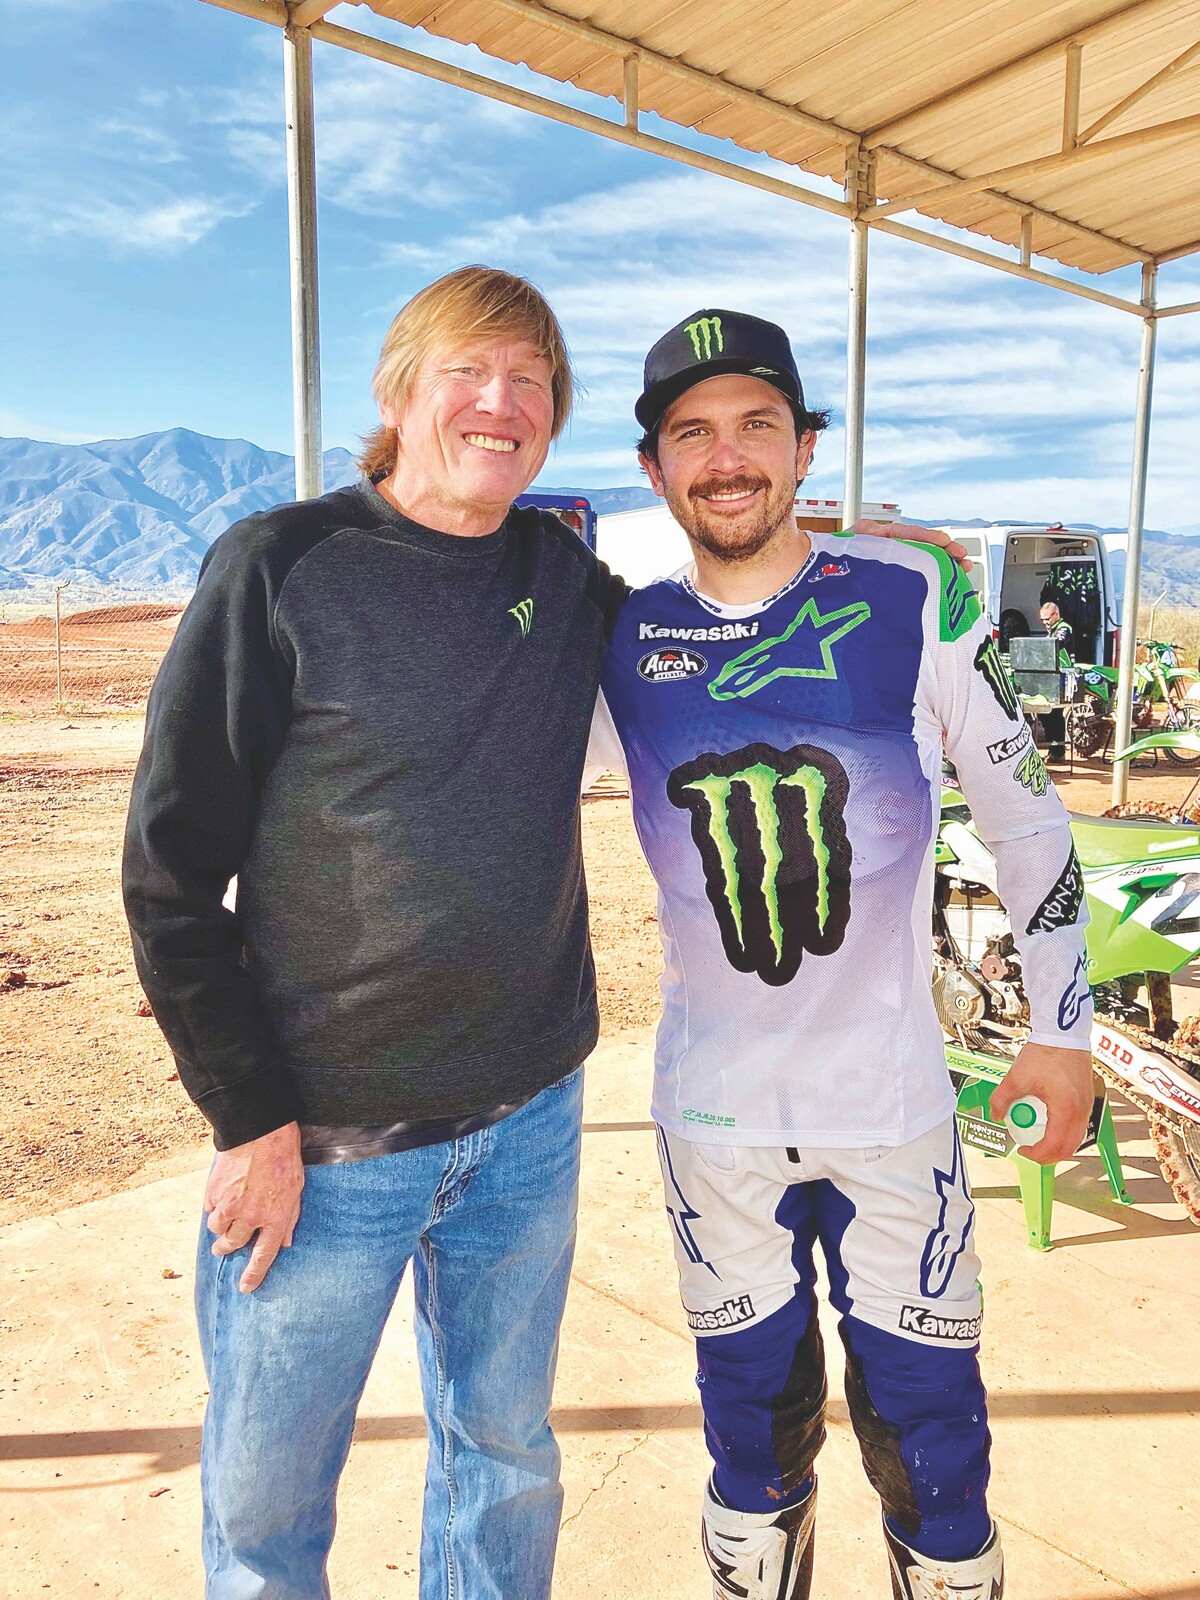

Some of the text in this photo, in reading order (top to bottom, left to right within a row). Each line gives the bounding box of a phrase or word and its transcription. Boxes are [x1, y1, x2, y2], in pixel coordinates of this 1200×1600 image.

[638, 621, 759, 642] Kawasaki
[643, 652, 699, 674] Airoh
[1098, 1035, 1134, 1066] DID
